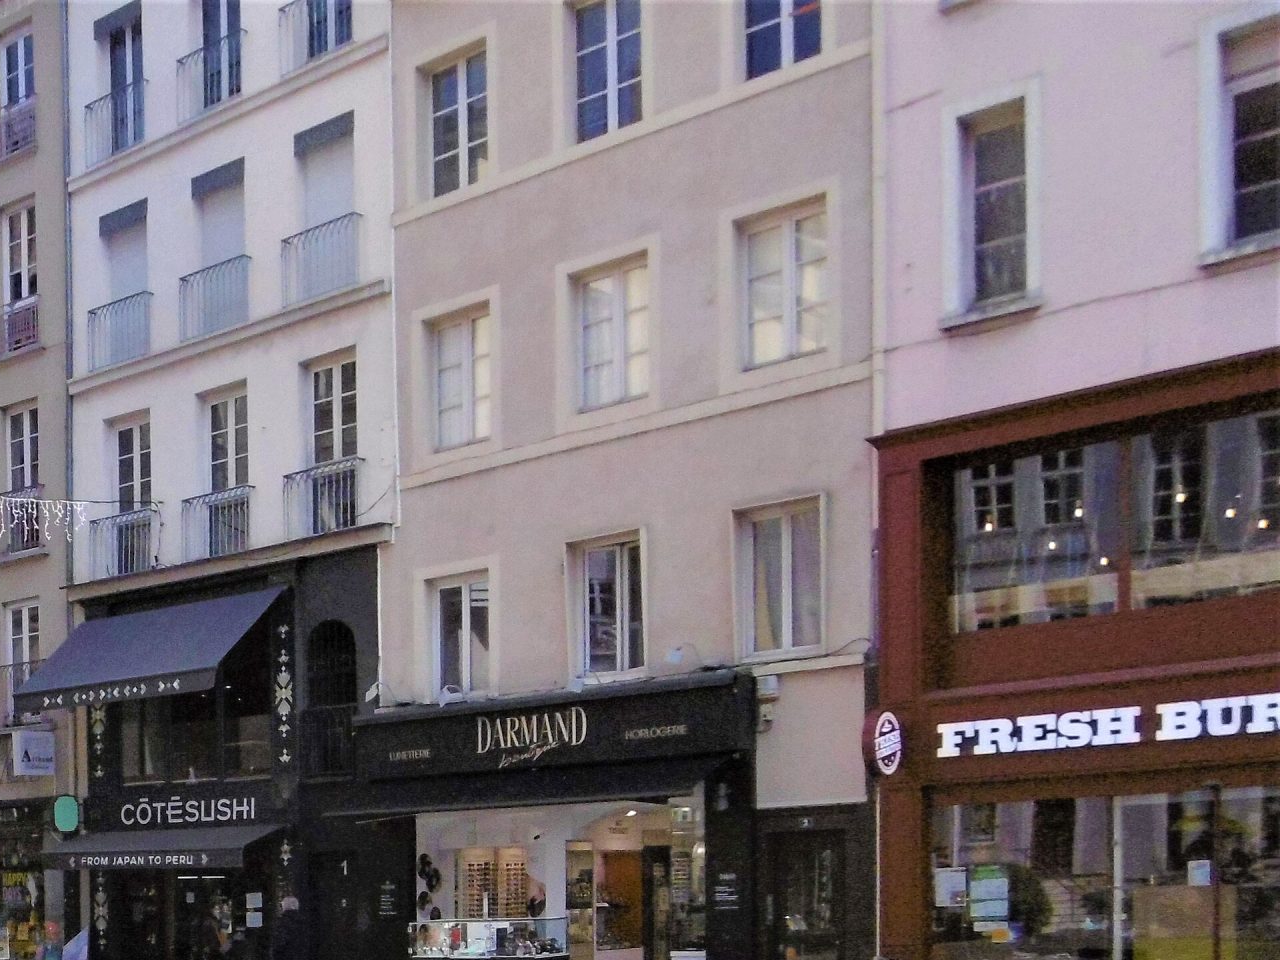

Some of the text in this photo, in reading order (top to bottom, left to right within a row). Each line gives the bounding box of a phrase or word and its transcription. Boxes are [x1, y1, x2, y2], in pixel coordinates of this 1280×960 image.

[476, 706, 588, 754] DARMAND
[624, 724, 688, 740] HORLOGERIE
[936, 692, 1280, 758] FRESH BUR
[81, 855, 194, 866] FROM JAPAN TO PERU
[340, 860, 348, 875] 1
